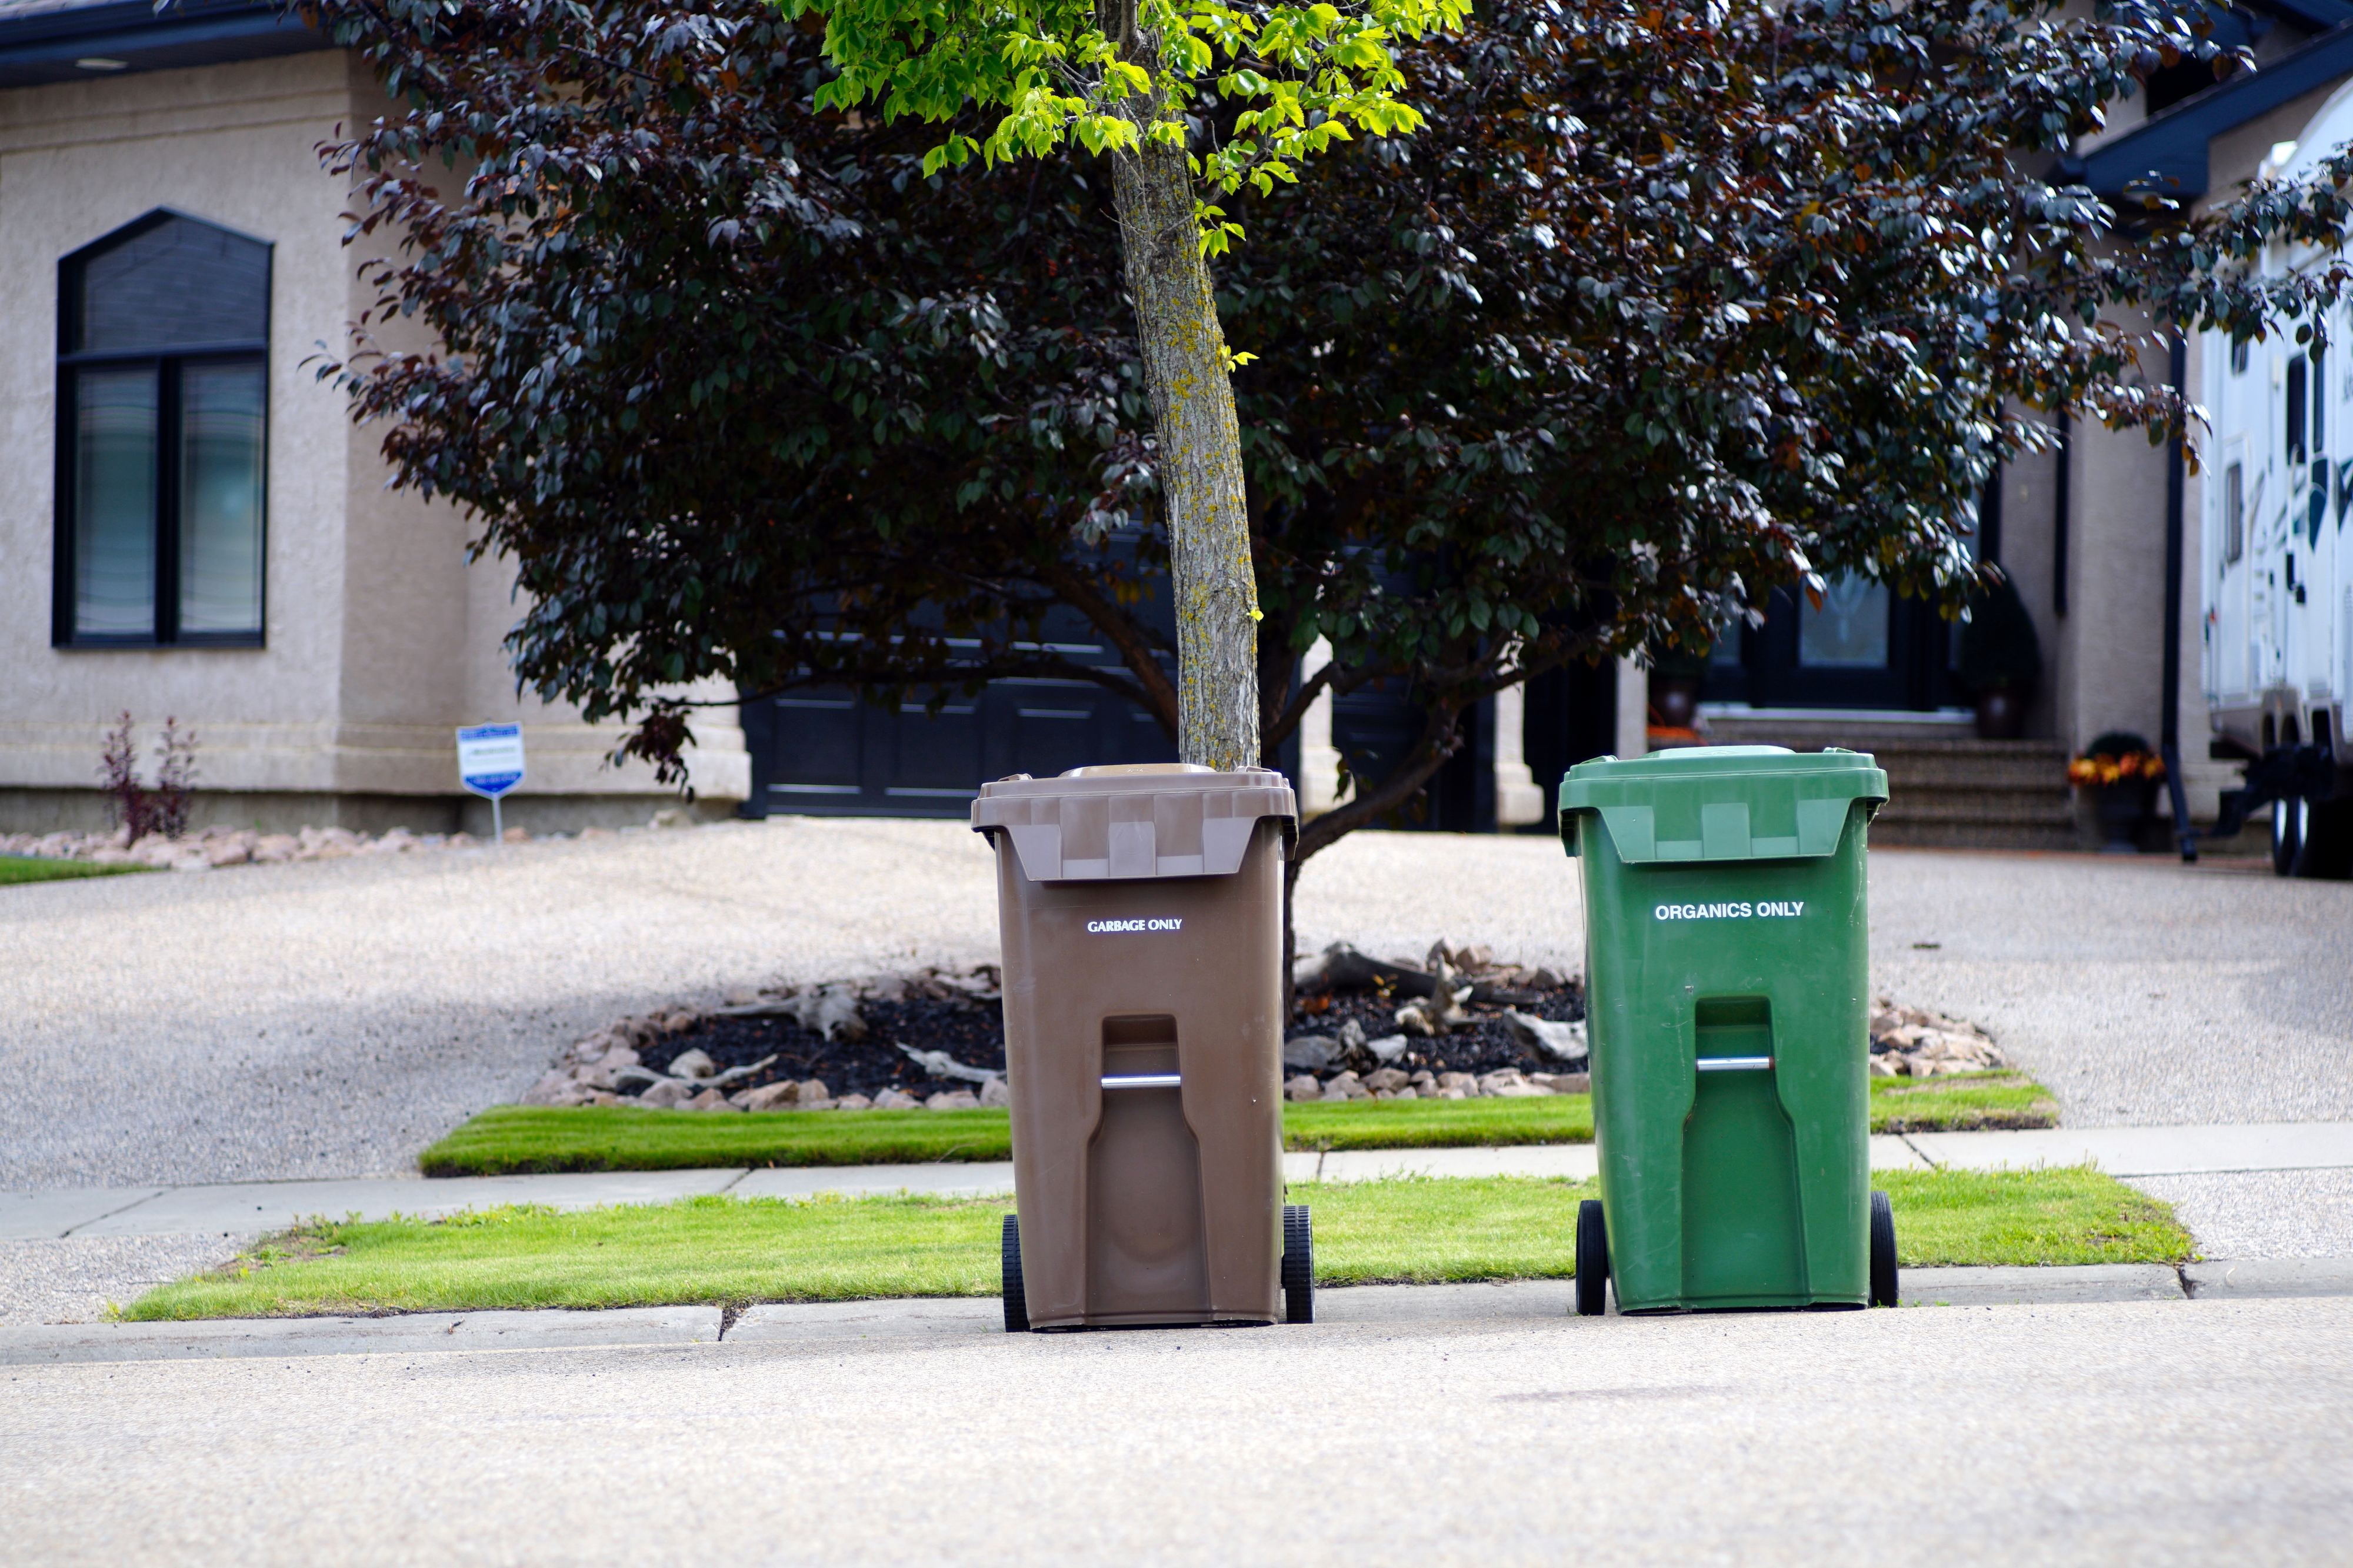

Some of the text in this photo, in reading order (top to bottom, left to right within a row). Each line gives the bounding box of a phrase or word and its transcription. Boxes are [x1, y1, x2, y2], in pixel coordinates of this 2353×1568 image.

[1655, 902, 1804, 920] ORGANICS ONLY
[1087, 919, 1182, 932] GARBAGE ONLY
